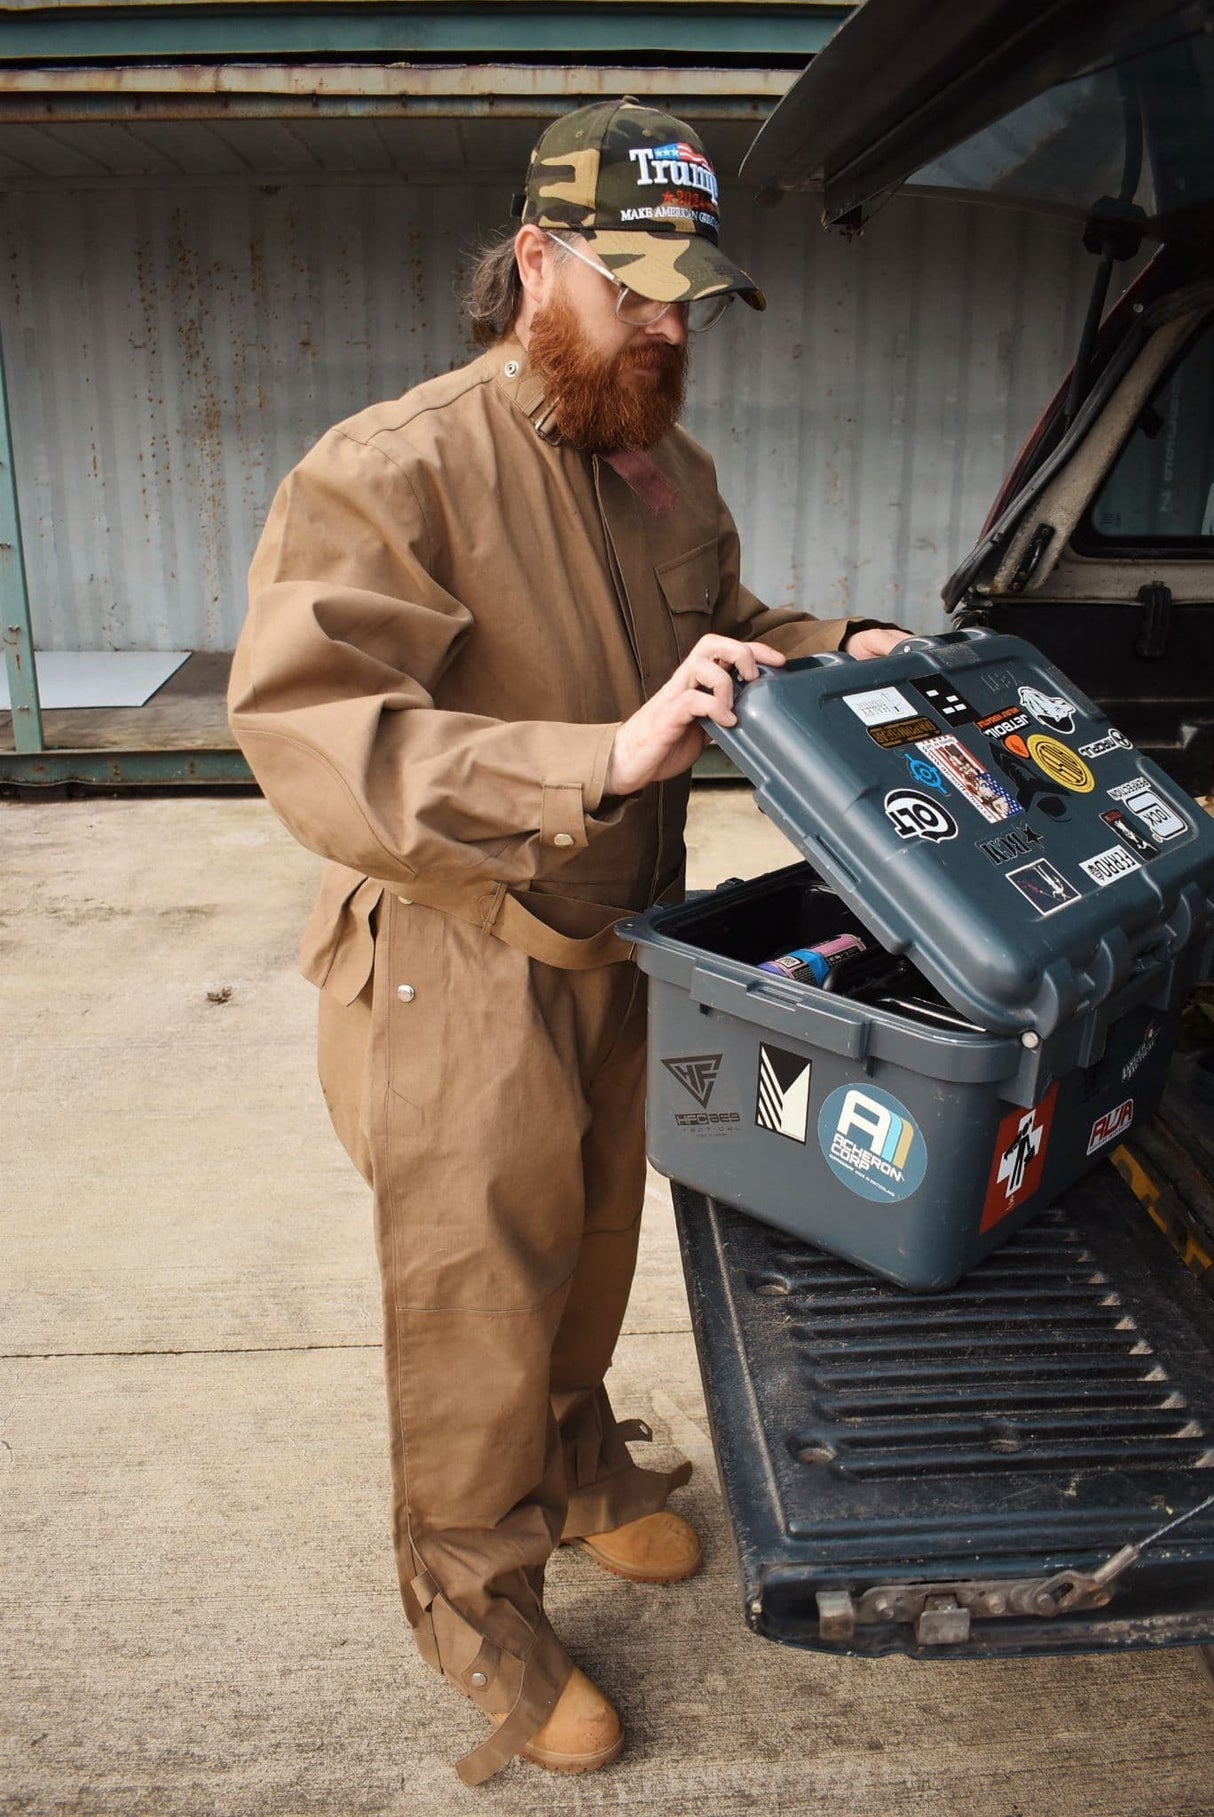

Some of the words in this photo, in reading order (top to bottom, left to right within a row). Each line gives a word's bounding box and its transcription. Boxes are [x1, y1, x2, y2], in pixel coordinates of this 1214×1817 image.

[629, 149, 719, 206] Trump
[620, 207, 653, 222] MAKE
[985, 714, 1030, 739] JETBOIL
[1094, 849, 1136, 878] FERRO
[830, 1143, 870, 1171] CORP
[833, 1133, 903, 1182] ACHERON
